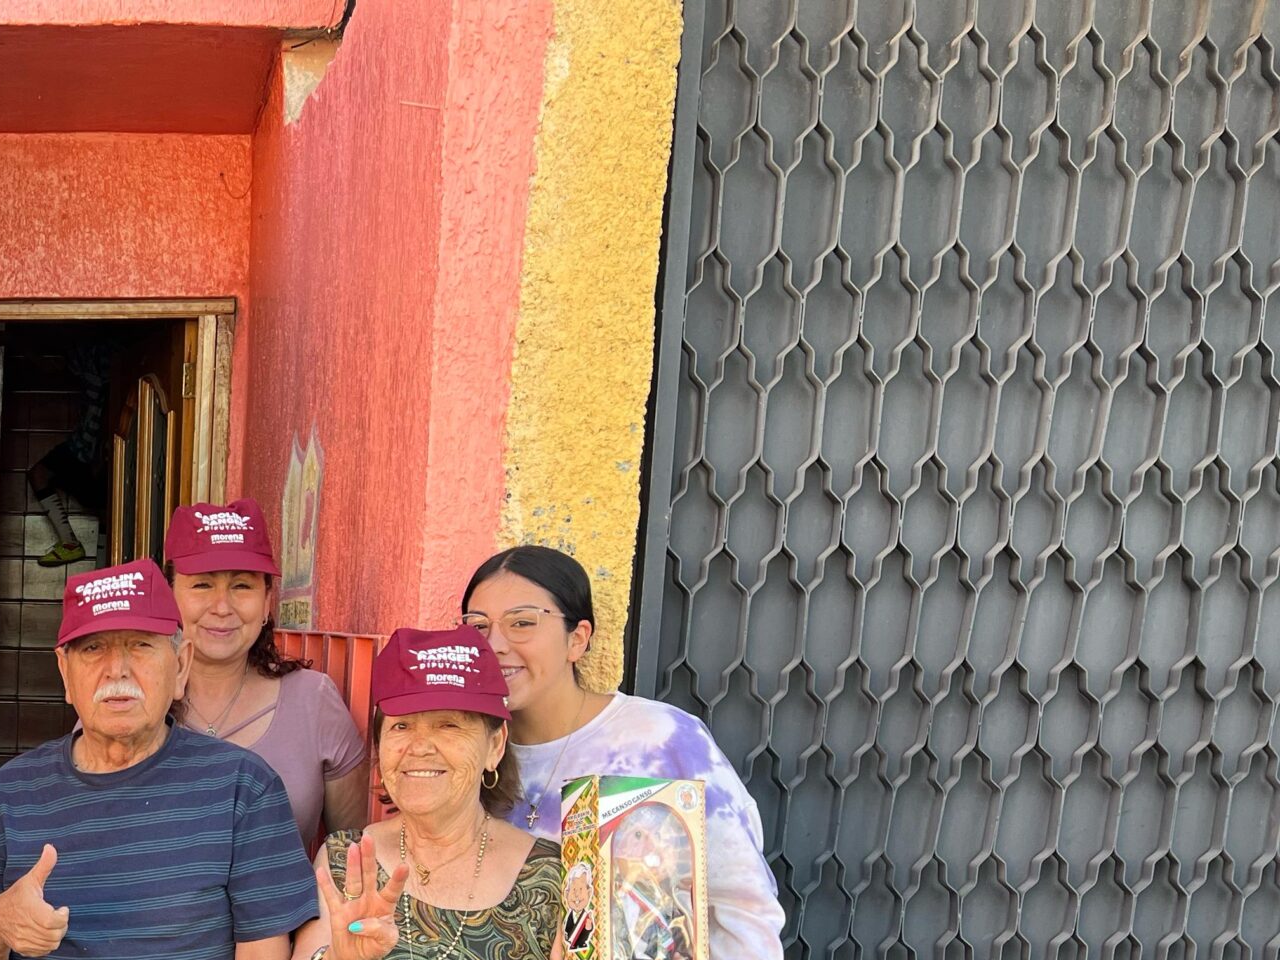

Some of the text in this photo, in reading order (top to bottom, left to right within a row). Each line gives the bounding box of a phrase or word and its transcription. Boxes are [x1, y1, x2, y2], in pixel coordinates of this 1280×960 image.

[76, 572, 144, 593] CAROLINA
[83, 580, 136, 596] RANGEL
[92, 600, 130, 612] morena
[417, 652, 473, 662] RANGEL
[420, 662, 471, 672] DIPUTADA
[426, 674, 465, 684] morena
[611, 800, 633, 816] CANSO
[631, 789, 652, 804] CANSO
